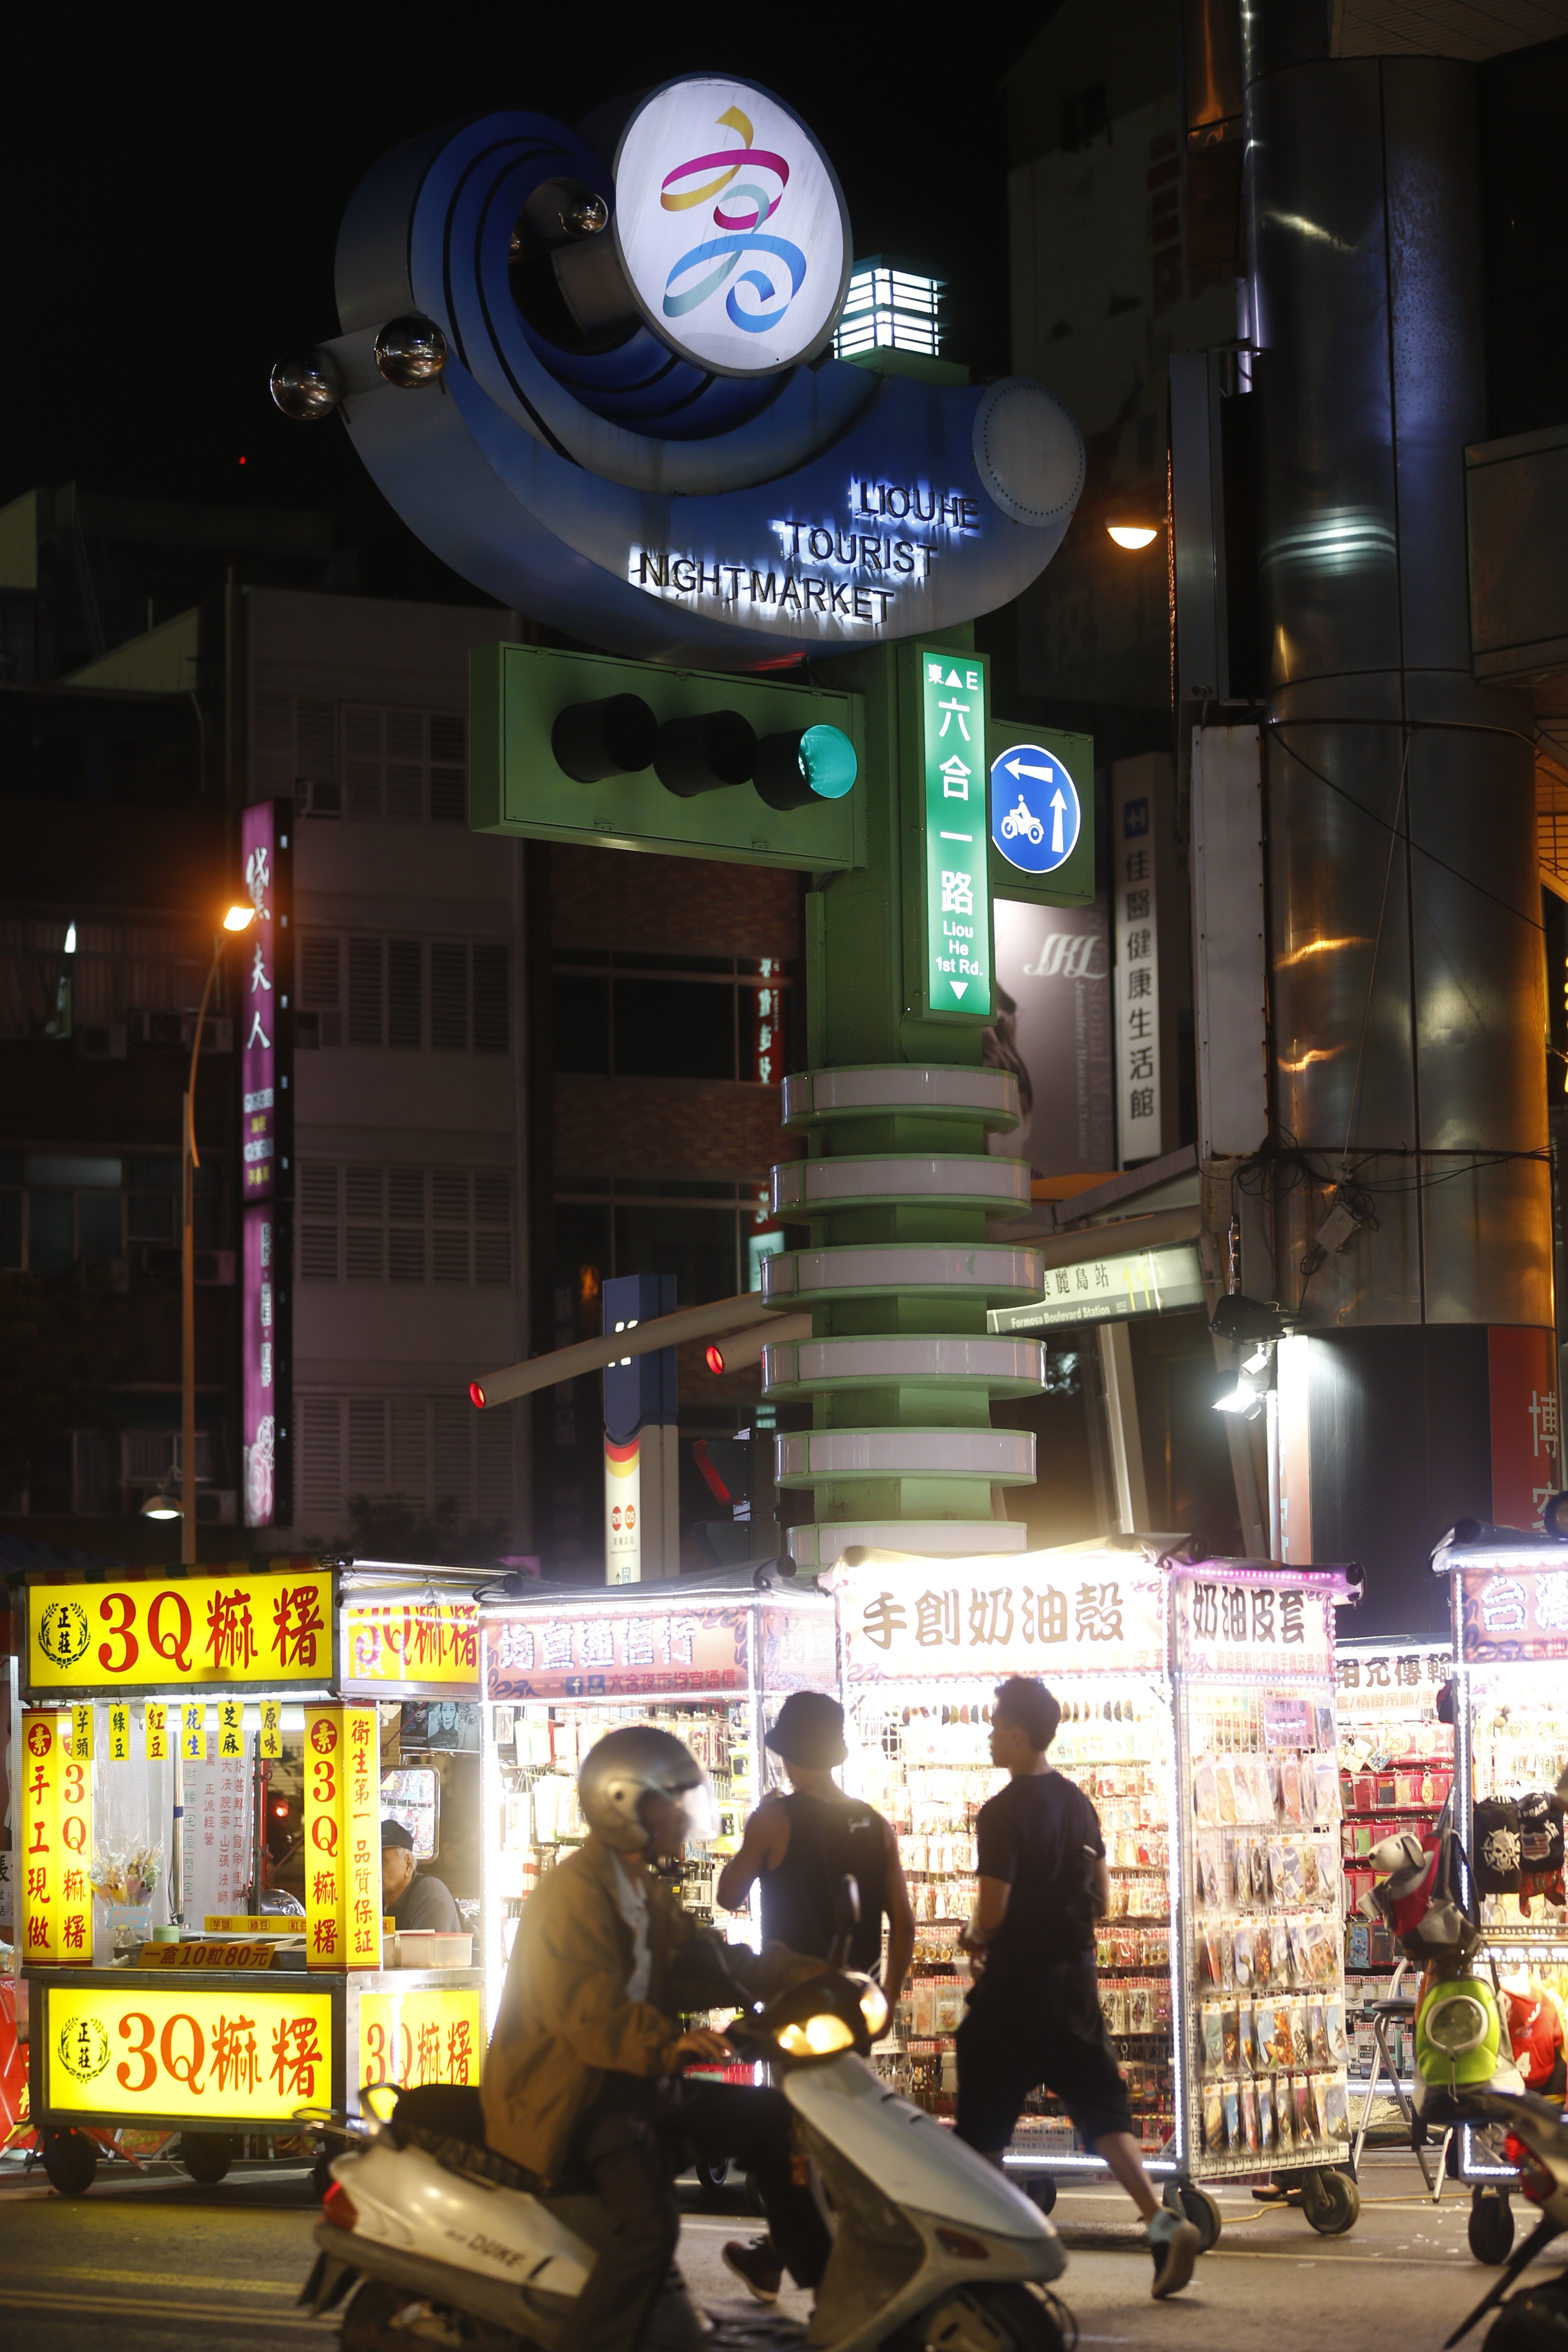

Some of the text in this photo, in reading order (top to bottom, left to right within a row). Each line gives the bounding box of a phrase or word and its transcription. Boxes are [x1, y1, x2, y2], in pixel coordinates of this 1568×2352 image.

[859, 481, 980, 530] LIOUHE
[784, 520, 938, 578] TOURIST
[639, 552, 895, 624] NIGHTMARKET
[928, 663, 979, 691] 東 E
[937, 697, 974, 916] 六合一路
[943, 920, 974, 939] Liou
[948, 939, 969, 956] He
[936, 956, 984, 976] 1st Rd.
[1126, 849, 1154, 1121] 佳醫健康生活館
[1011, 1317, 1043, 1329] Formosa
[1044, 1309, 1082, 1324] Boulevard
[1082, 1305, 1111, 1321] Station
[612, 1512, 622, 1525] R10
[1193, 1581, 1304, 1644] 奶油皮套
[76, 1710, 89, 1758] 芋頭
[148, 1708, 165, 1758] 紅豆
[186, 1708, 201, 1756] 花生
[222, 1706, 240, 1754] 芝麻
[263, 1707, 277, 1755] 原味
[1389, 1737, 1407, 1750] 250
[27, 1765, 51, 1950] 手工現做
[144, 1944, 270, 1968] 一盒10粒80元
